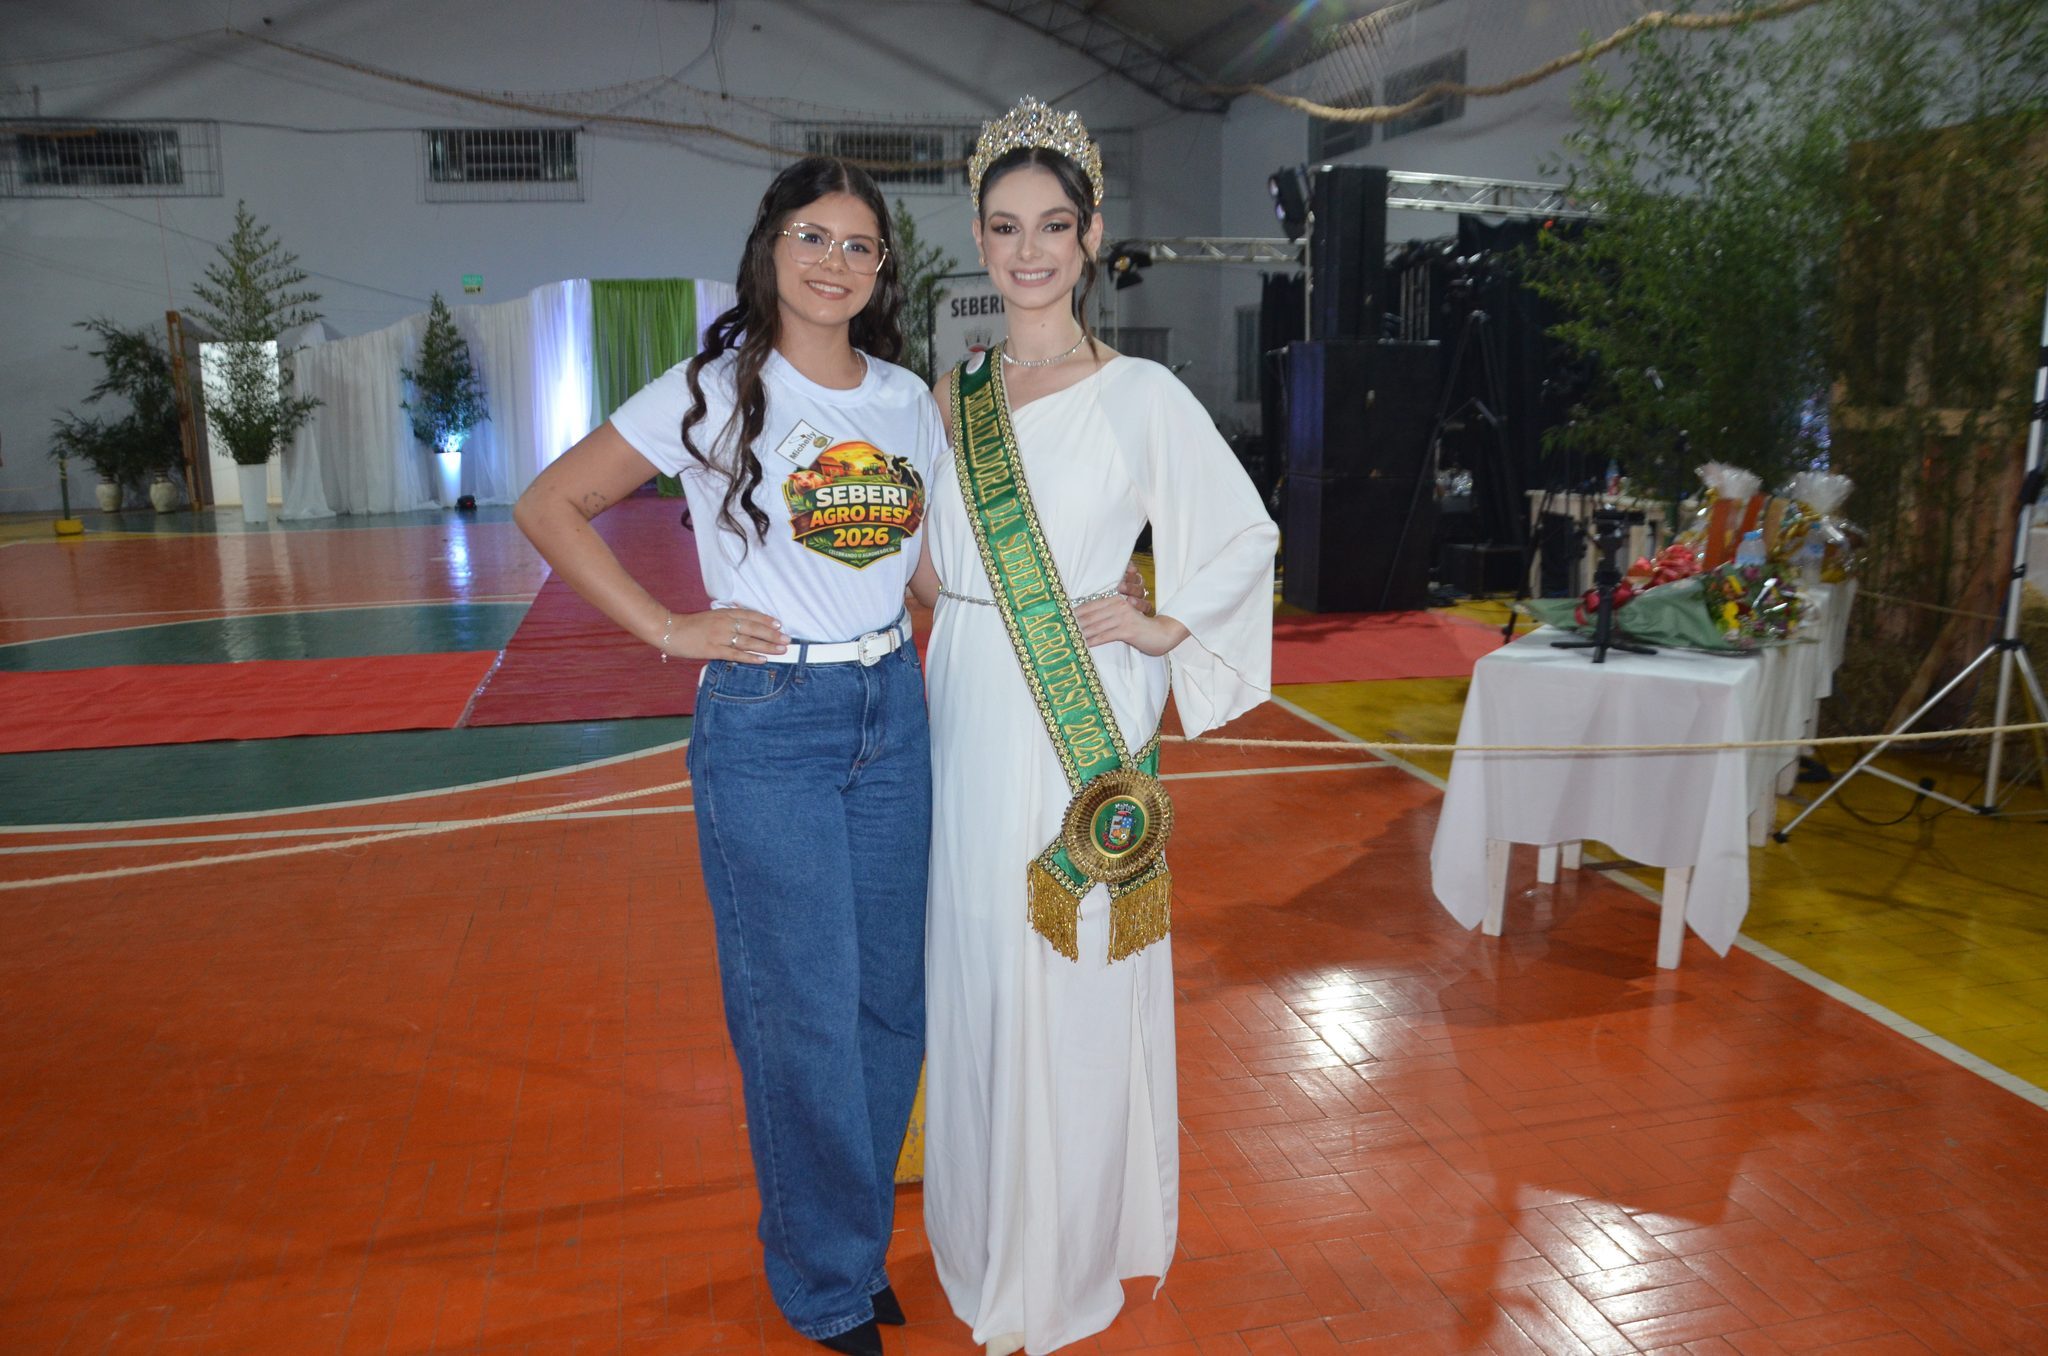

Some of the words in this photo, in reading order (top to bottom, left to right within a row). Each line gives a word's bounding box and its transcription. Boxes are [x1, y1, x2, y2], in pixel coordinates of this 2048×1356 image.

[789, 431, 817, 461] Michelly
[963, 380, 1016, 505] EMBAIXADORA
[809, 505, 866, 528] AGRO
[868, 506, 912, 525] FEST
[815, 485, 908, 508] SEBERI
[984, 498, 1022, 535] DA
[833, 527, 889, 547] 2026
[995, 531, 1051, 611] SEBERI
[1021, 611, 1071, 666] AGRO
[1042, 661, 1092, 717] FEST
[1063, 714, 1114, 768] 2025
